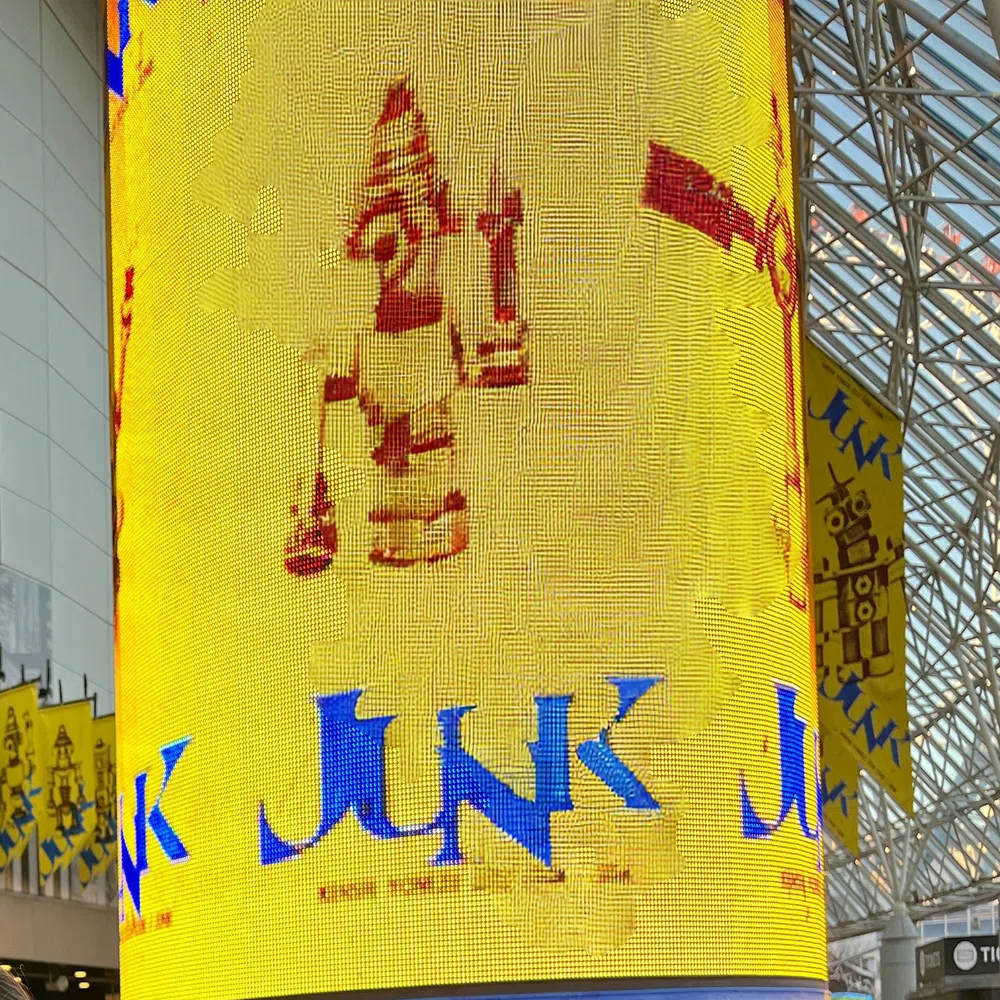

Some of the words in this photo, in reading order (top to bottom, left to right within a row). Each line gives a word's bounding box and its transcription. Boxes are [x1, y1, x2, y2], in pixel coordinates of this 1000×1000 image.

[807, 387, 902, 482] JUNK
[819, 671, 911, 768] JUNK
[259, 675, 666, 868] JUNK
